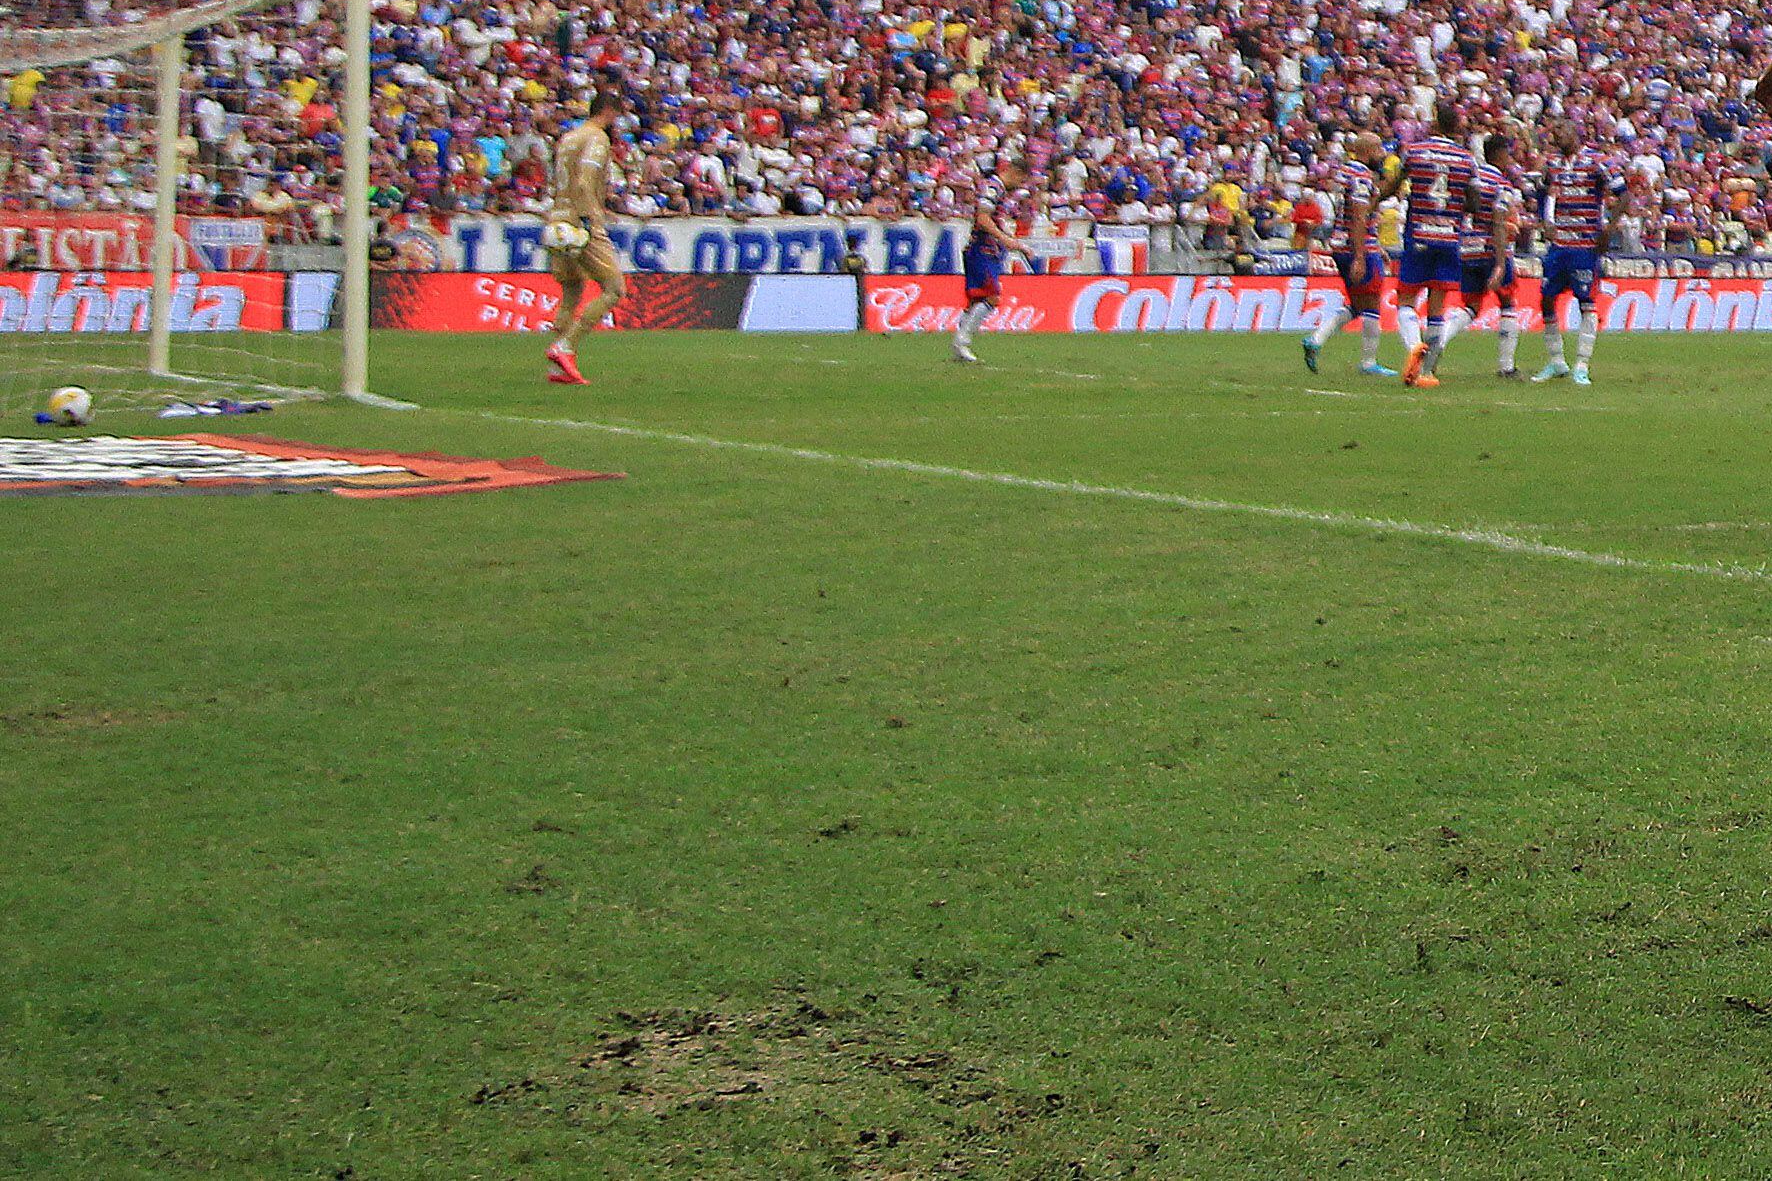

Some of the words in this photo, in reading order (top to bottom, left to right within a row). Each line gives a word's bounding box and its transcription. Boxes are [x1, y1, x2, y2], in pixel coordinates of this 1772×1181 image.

[1428, 173, 1452, 210] 4
[694, 228, 867, 273] OPEN
[885, 229, 966, 274] BA
[1072, 275, 1347, 331] Colônia
